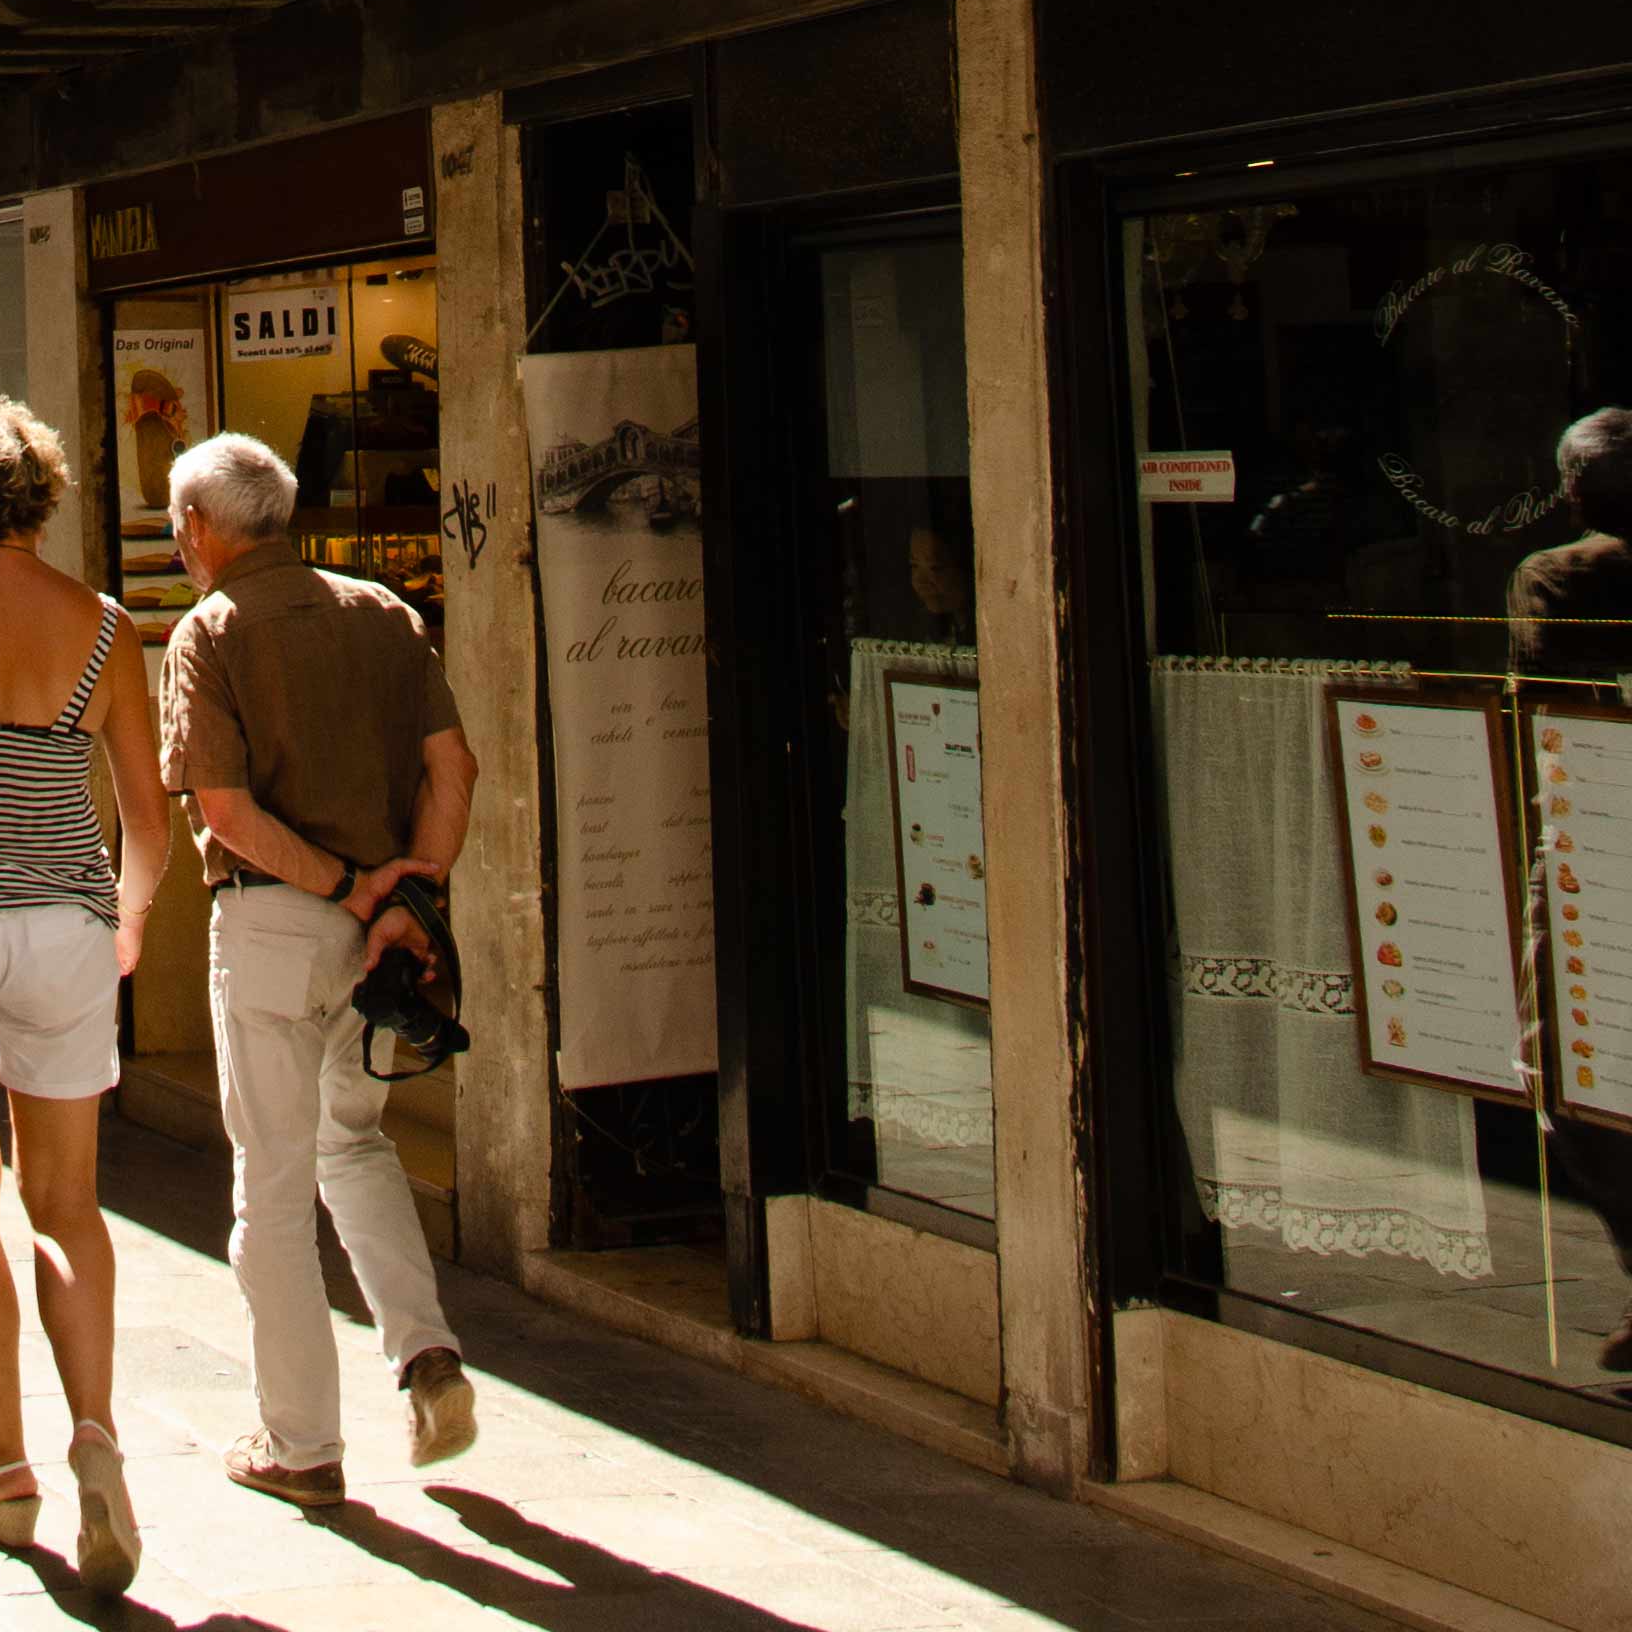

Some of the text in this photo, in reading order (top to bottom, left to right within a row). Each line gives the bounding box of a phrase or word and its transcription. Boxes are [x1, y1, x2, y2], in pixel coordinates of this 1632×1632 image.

[1373, 264, 1449, 349] Bacaro
[1452, 241, 1488, 274] al
[234, 306, 336, 341] SALDI
[115, 337, 194, 354] Das Original
[1141, 460, 1231, 474] AIR CONDITIONED
[1169, 479, 1201, 492] INSIDE
[601, 559, 705, 605] bacaro
[566, 615, 710, 663] al ravan
